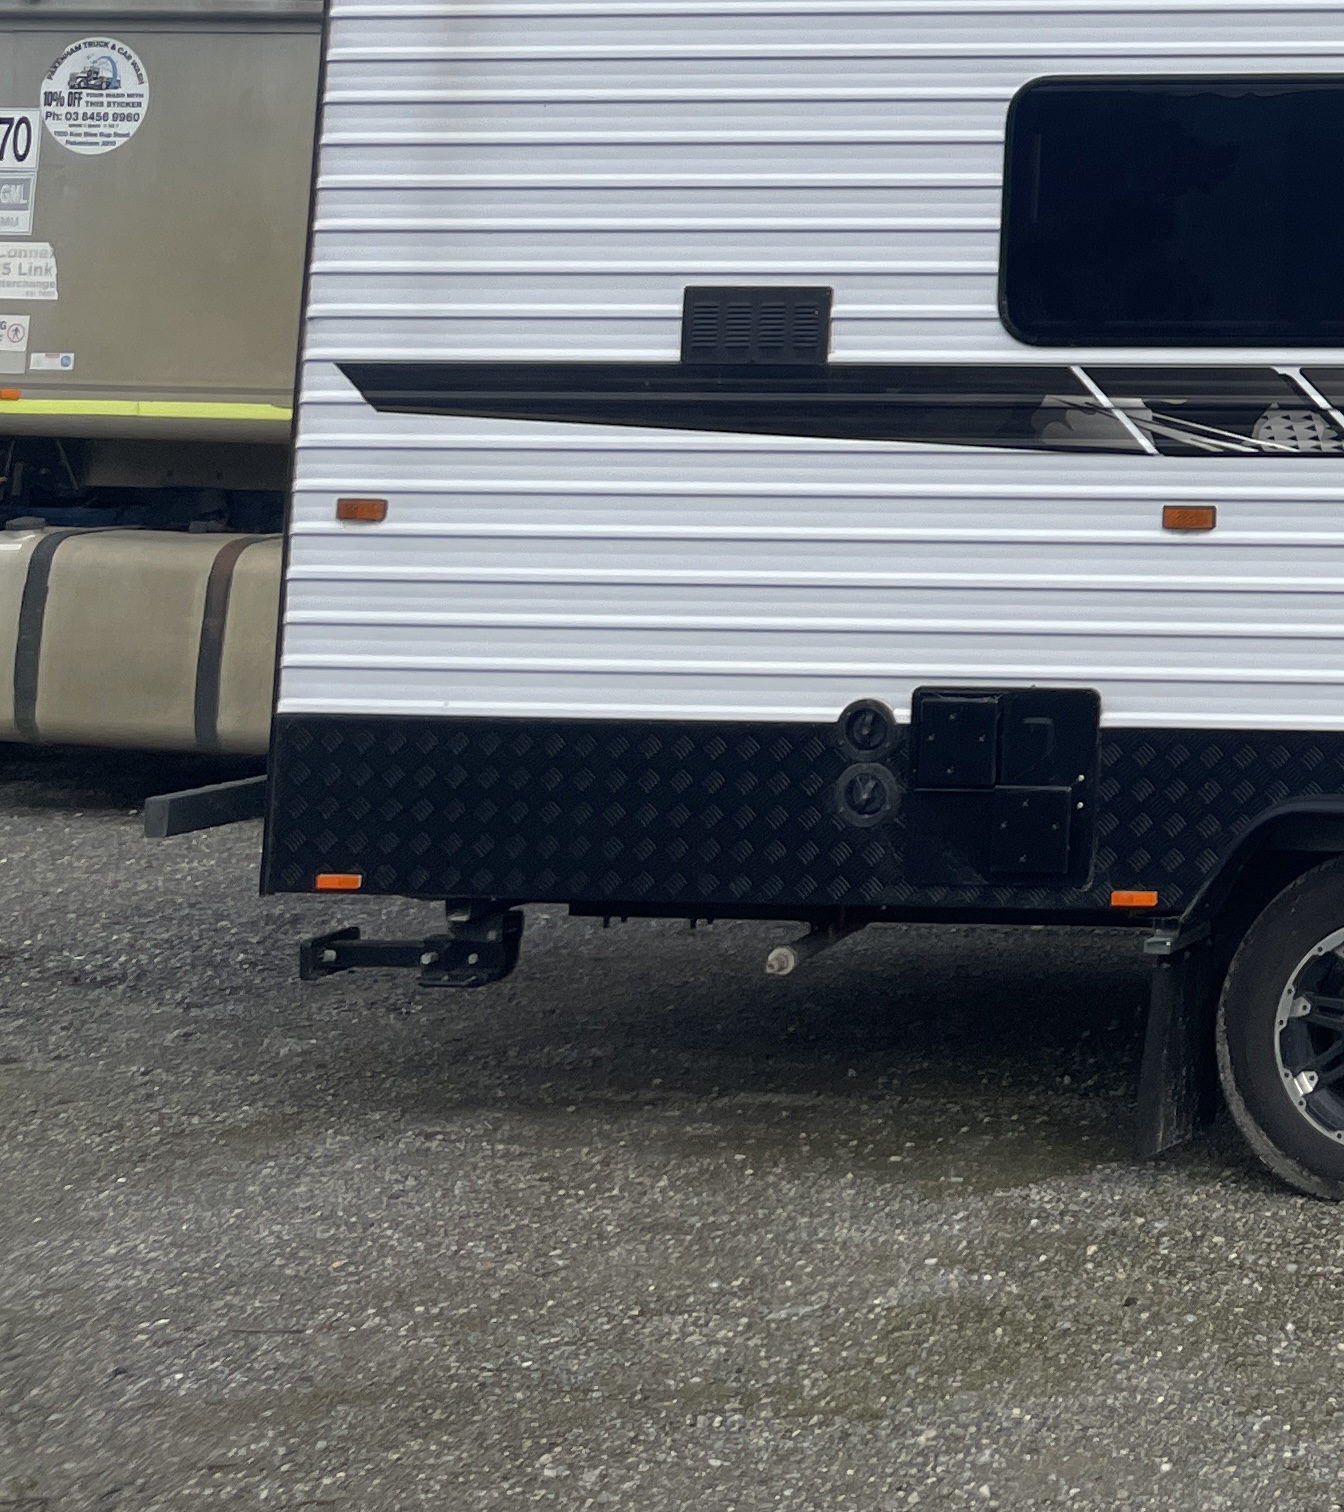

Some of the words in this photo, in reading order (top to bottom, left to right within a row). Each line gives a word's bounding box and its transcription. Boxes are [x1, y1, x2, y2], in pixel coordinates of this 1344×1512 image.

[82, 40, 110, 49] TRUCK
[117, 47, 133, 61] CAR
[43, 90, 65, 107] 10%
[67, 90, 83, 107] OFF
[106, 100, 143, 108] STICKER
[45, 110, 62, 121] Ph:
[64, 111, 79, 121] 03
[18, 261, 53, 276] Link
